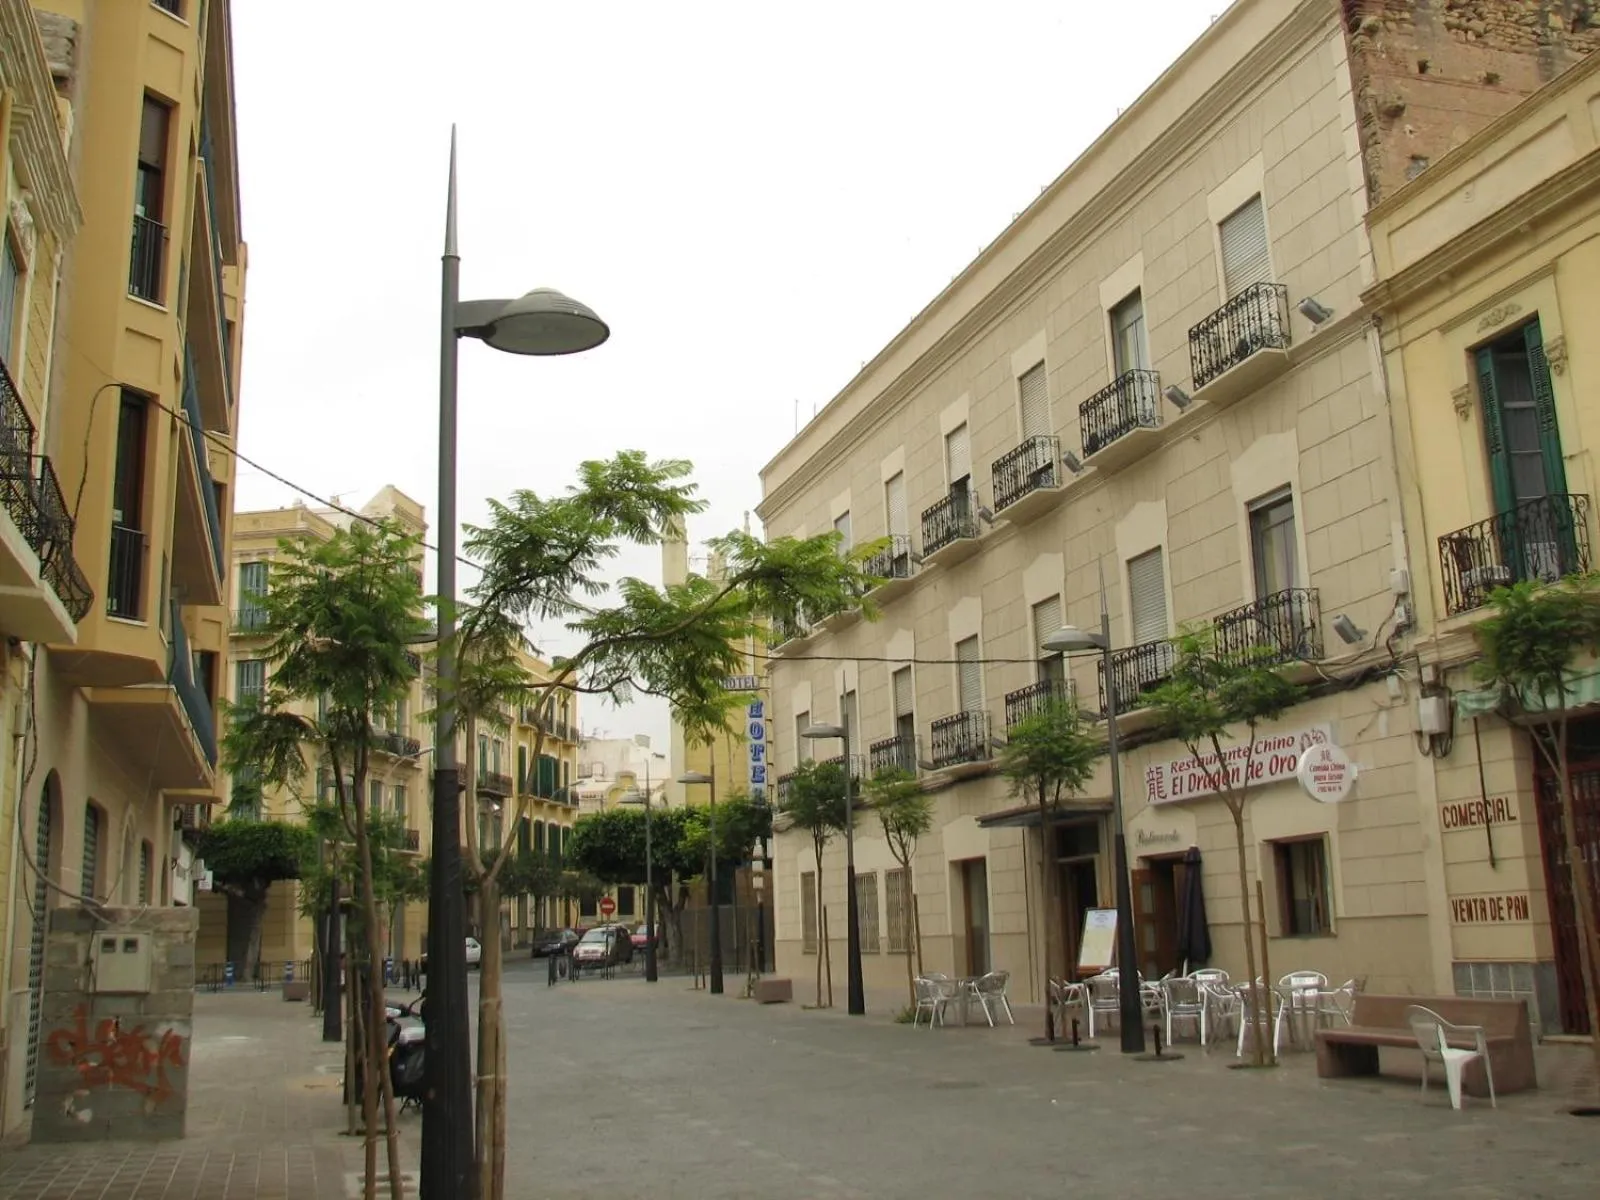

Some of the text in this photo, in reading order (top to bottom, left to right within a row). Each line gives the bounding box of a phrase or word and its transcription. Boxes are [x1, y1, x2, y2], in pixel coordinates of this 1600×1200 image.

[1171, 736, 1295, 774] Restaurante Chino
[1172, 776, 1183, 796] El
[1247, 758, 1264, 781] de
[1269, 754, 1297, 777] Oro
[1442, 797, 1517, 829] COMERCIAL
[1452, 895, 1529, 922] VENTA DE PAN
